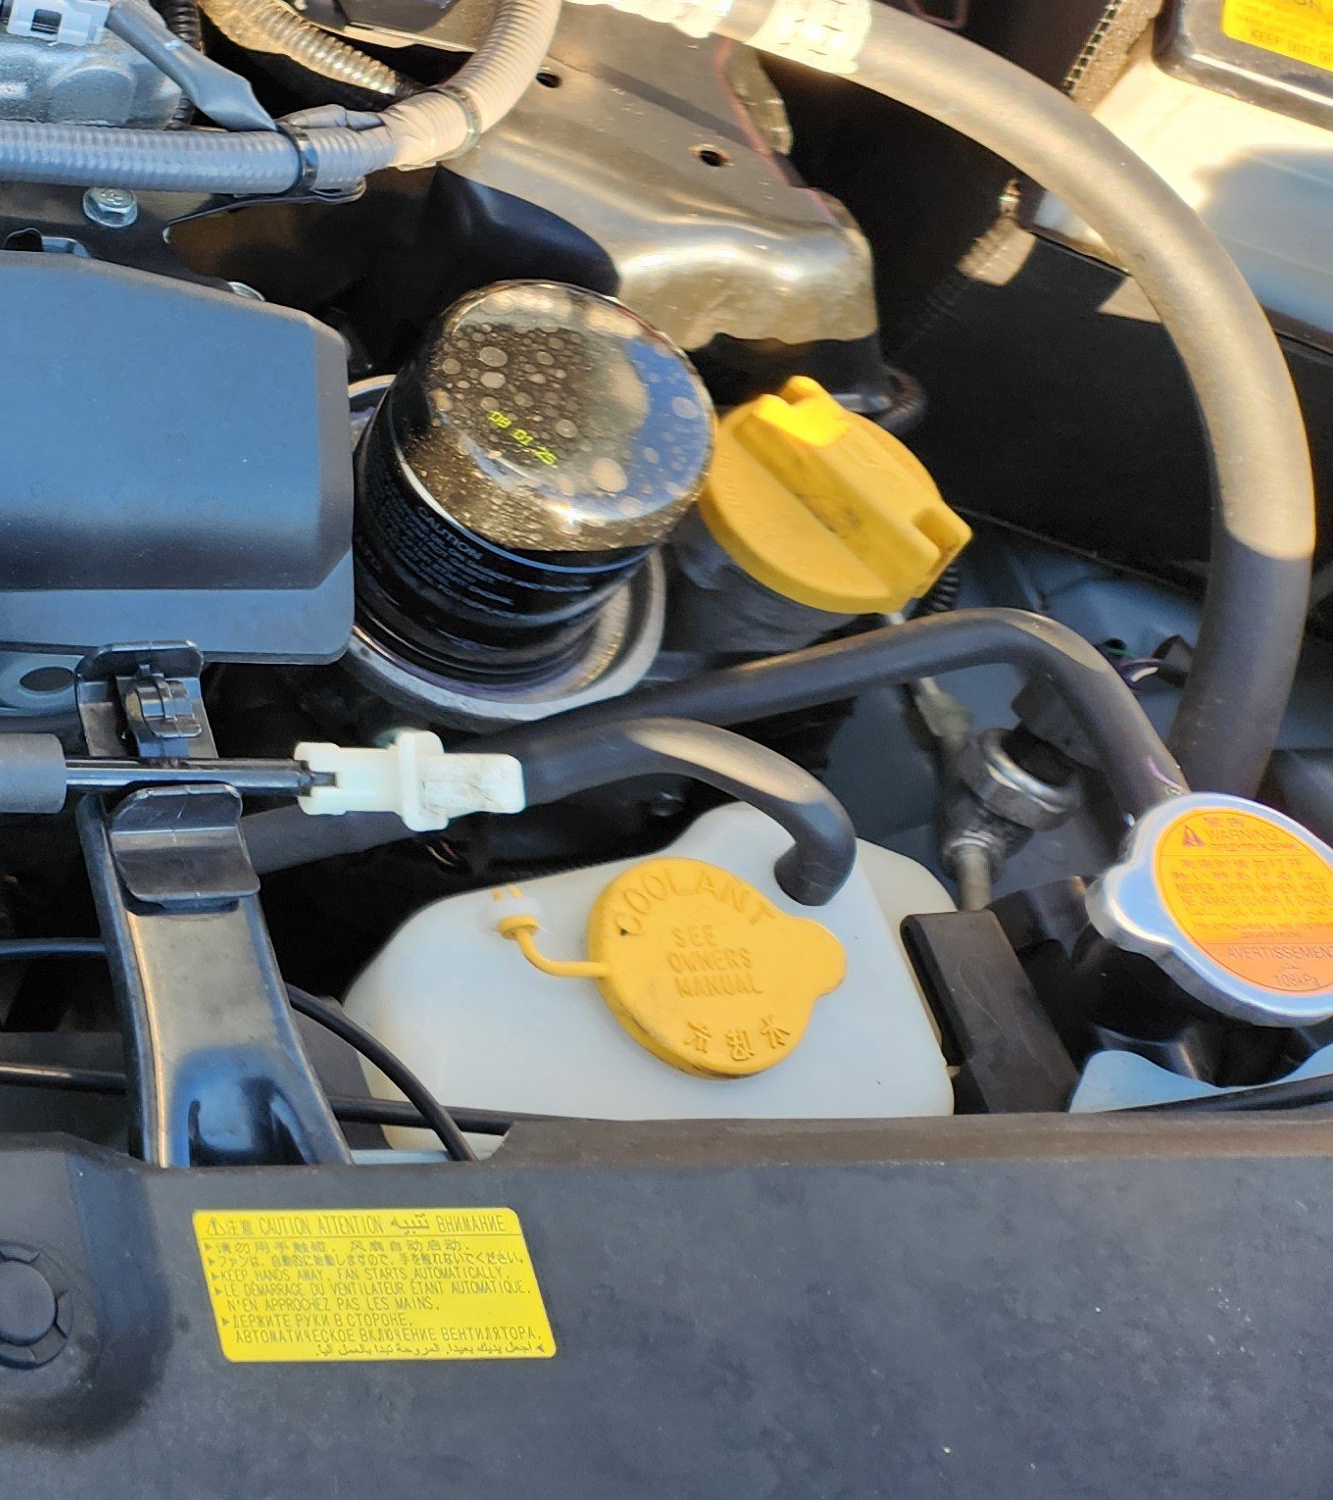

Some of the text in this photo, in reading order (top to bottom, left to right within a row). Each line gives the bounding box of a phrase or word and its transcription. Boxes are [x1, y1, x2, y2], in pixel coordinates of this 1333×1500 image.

[1205, 829, 1279, 841] WARNING
[613, 867, 778, 938] COOLANT
[671, 924, 719, 948] SEE
[666, 947, 753, 974] OWNERS
[1228, 946, 1333, 959] AVERTISSEMEN
[673, 972, 764, 998] MANUAL
[259, 1216, 312, 1236] CAUTION
[318, 1213, 383, 1236] ATTENTION
[436, 1214, 507, 1233] ВНИМАНИЕ
[220, 1266, 510, 1282] KEEP HANDS AWAY. FAN STARTS AUTOMATICALLY.
[224, 1280, 531, 1297] LE DÉMARRAGE DU VENTILATEUR ÉTANT AUTOMATIQUE.
[227, 1296, 440, 1312] N'EN APPROCHEZ PAS LES MAINS.
[233, 1312, 413, 1329] ДЕРЖИТЕ РУКИ В СТОРОНЕ.
[236, 1326, 542, 1344] АВТОМАТИЧЕСКОЕ ВКЛЮЧЕНИЕ ВЕНТИЛЯТОРА.
